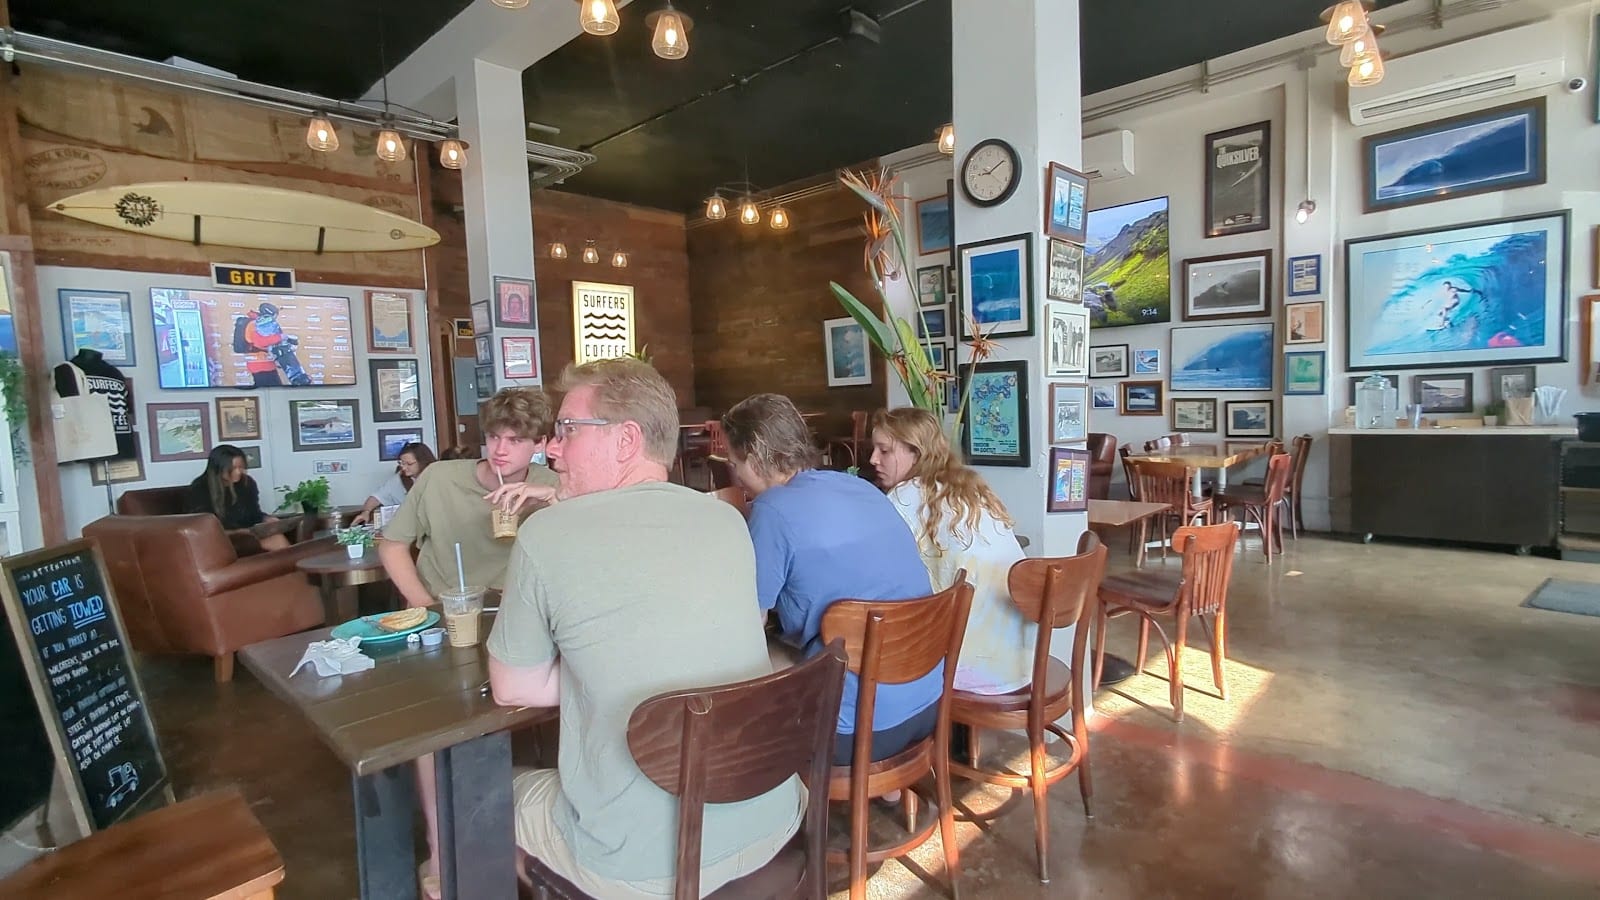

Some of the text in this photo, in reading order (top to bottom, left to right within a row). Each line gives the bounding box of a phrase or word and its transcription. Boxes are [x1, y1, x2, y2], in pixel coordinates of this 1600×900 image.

[1216, 146, 1260, 169] QUIKSILVER
[230, 270, 277, 287] GRIT
[583, 294, 625, 310] SURFERS
[1141, 308, 1158, 317] 9:14
[585, 344, 626, 358] COFFEE
[86, 378, 126, 392] SURFERS
[112, 413, 128, 426] FEE
[22, 573, 84, 606] YOUR CAR IS
[31, 595, 104, 635] GETTING TOWED
